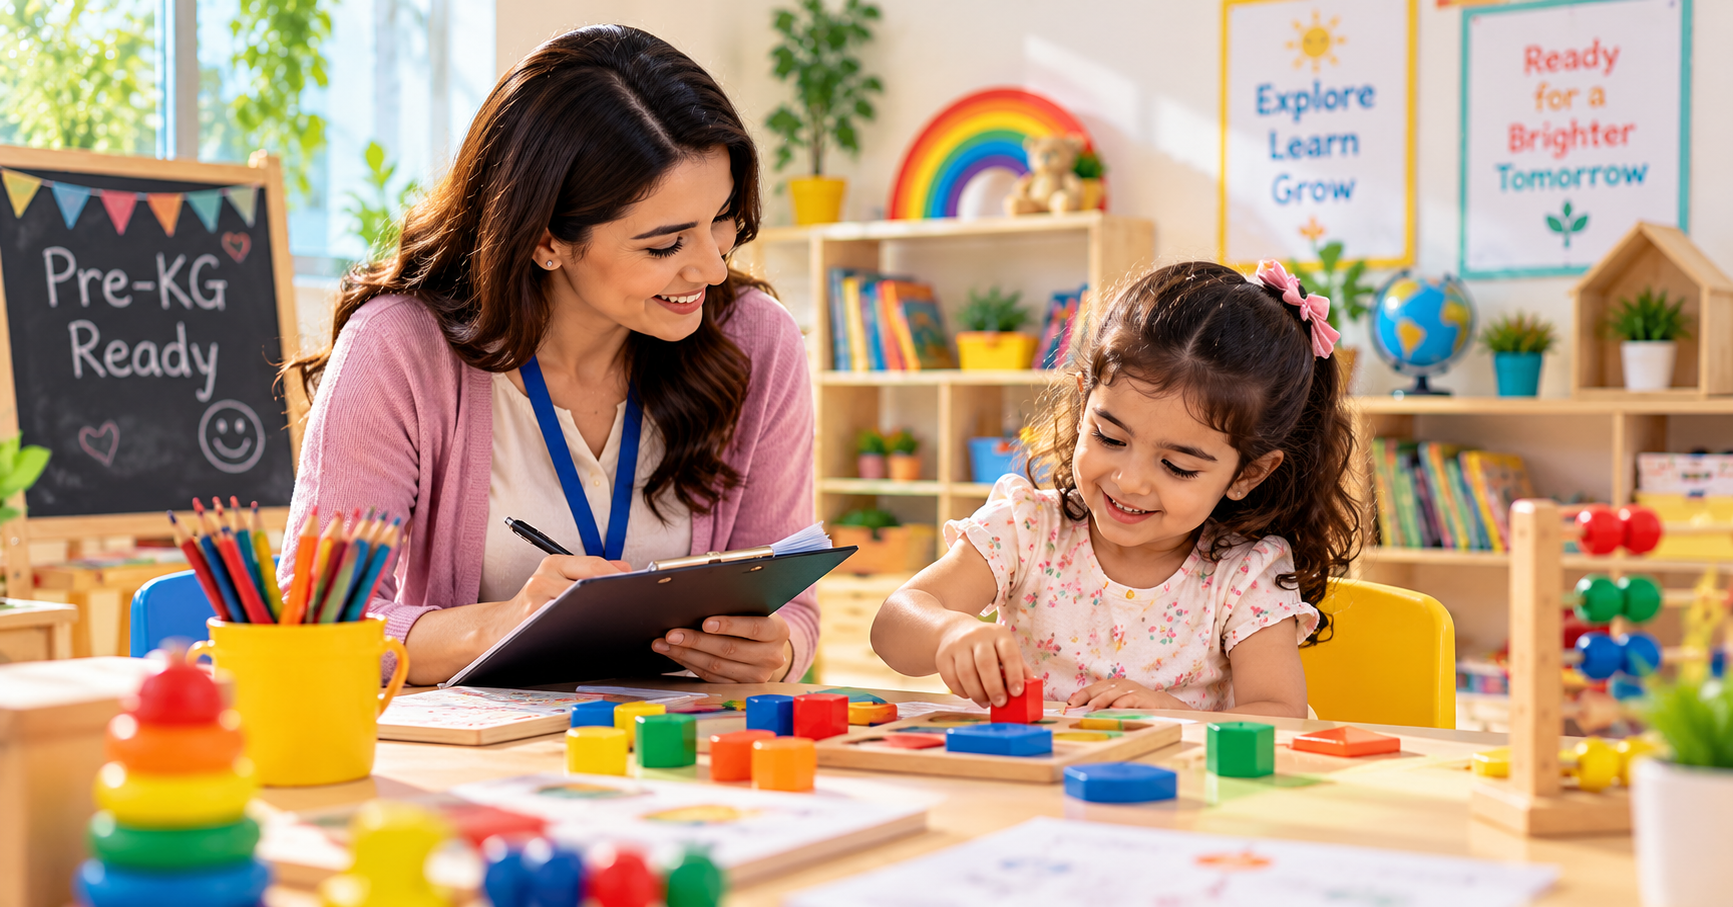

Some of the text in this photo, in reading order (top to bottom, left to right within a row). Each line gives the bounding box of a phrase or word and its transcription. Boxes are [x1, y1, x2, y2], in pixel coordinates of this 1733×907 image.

[1523, 38, 1620, 76] Ready
[1256, 80, 1376, 123] Explore
[1534, 82, 1606, 112] for a
[1269, 131, 1360, 161] Learn
[1508, 119, 1637, 160] Brighter
[1272, 173, 1356, 206] Grow
[1496, 161, 1650, 192] Tomorrow
[43, 246, 228, 311] Pre-KG
[68, 319, 219, 402] Ready
